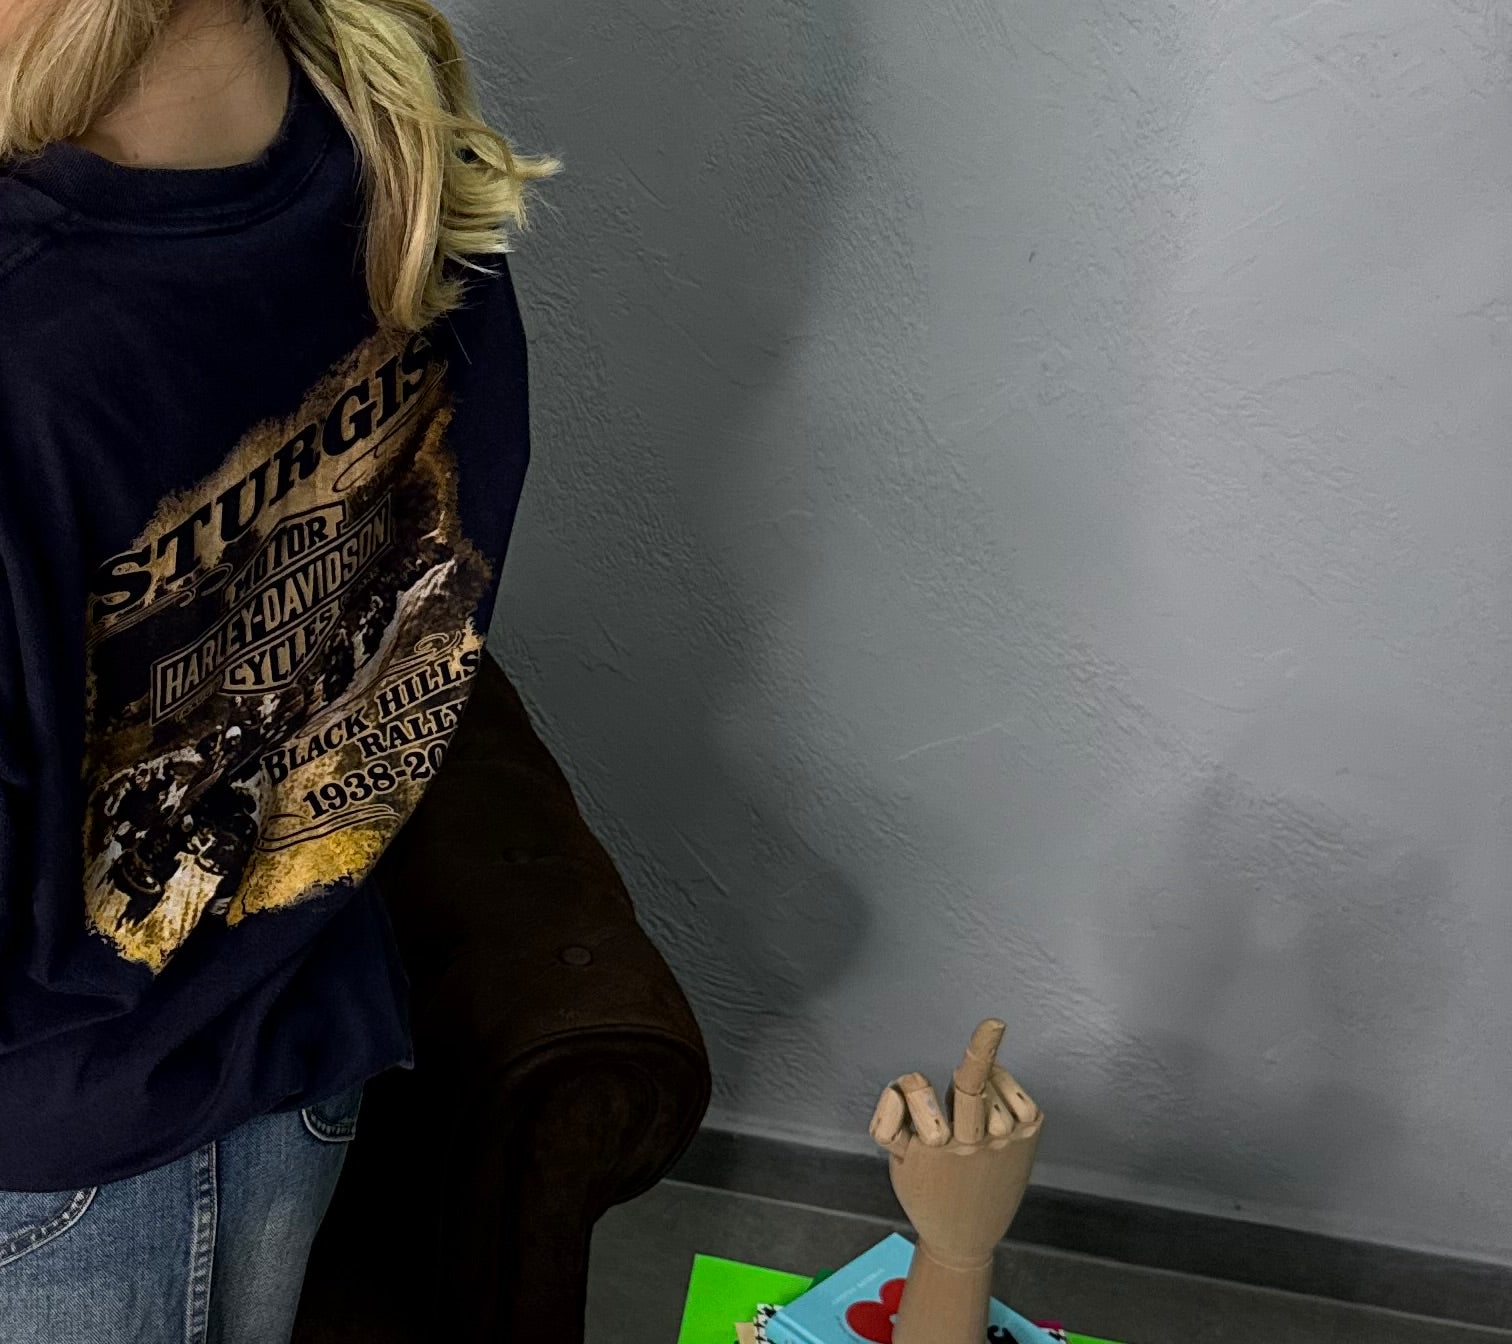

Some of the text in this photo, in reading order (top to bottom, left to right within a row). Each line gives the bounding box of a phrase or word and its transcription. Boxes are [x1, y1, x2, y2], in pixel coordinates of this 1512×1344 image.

[91, 337, 433, 618] STURGIS
[165, 507, 387, 708] HARLEY-DAVIDSON
[263, 648, 480, 785] BLACK HILLS
